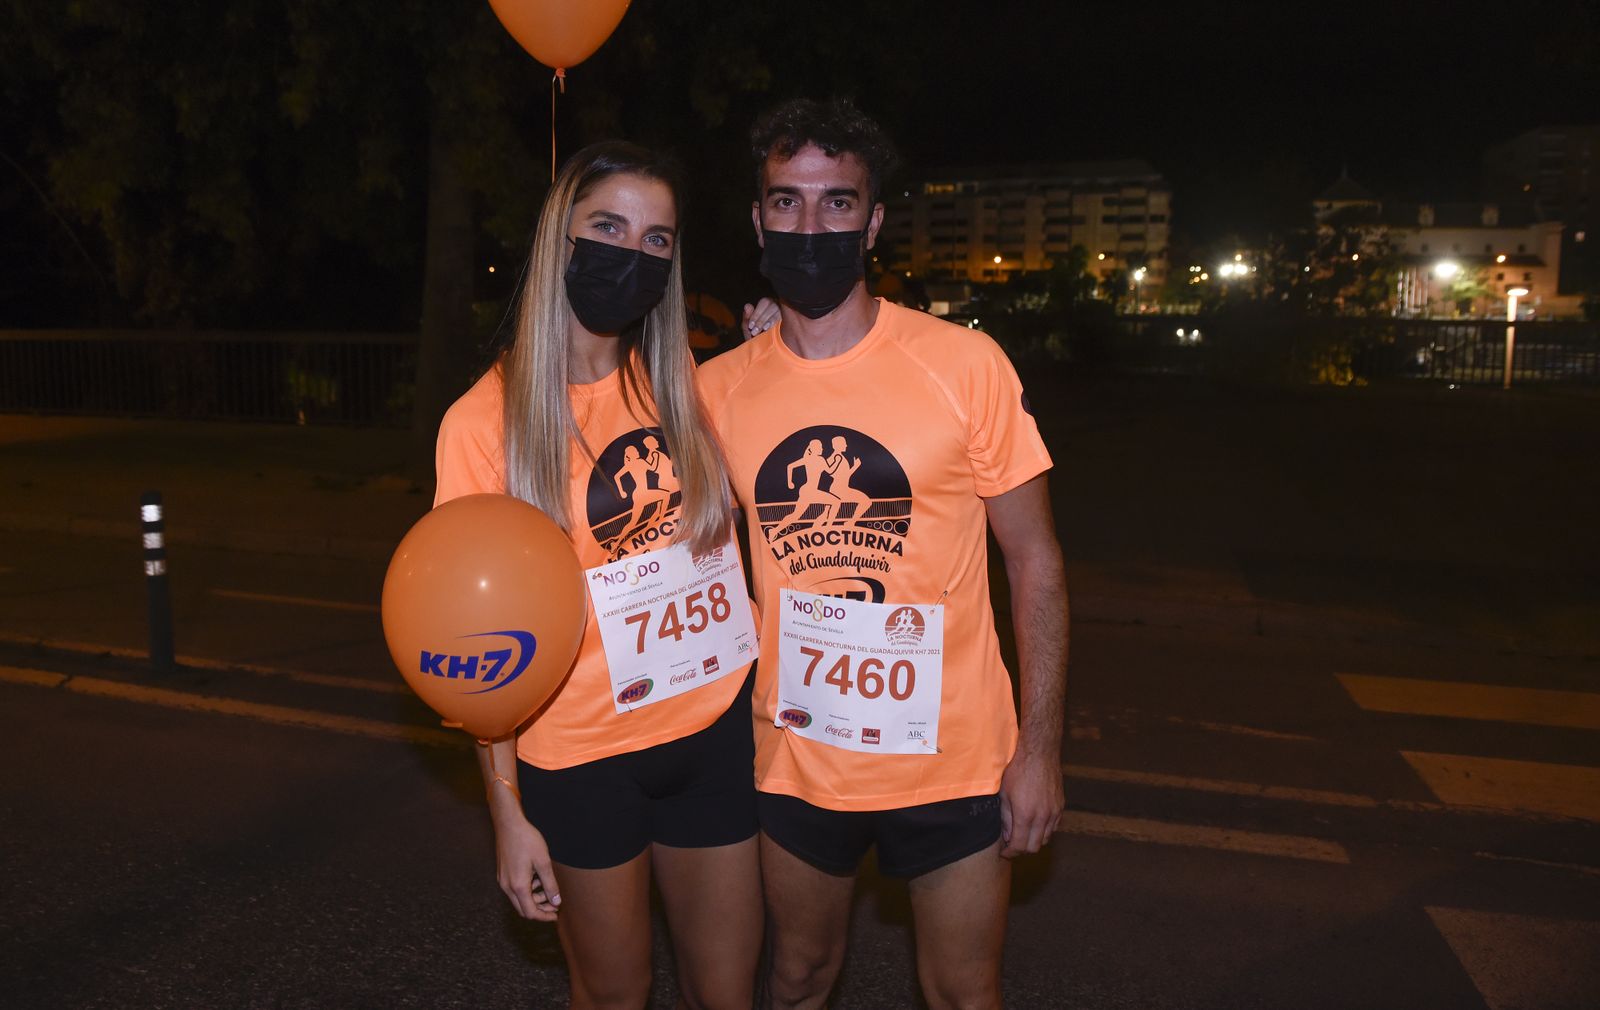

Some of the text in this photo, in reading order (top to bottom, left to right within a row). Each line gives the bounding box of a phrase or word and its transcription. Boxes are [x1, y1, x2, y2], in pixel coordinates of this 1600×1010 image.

[772, 530, 903, 561] LA NOCTURNA
[789, 550, 891, 575] del Guadalquivir
[620, 600, 647, 614] CARRERA
[647, 590, 678, 605] NOCTURNA
[678, 586, 687, 595] DEL
[687, 570, 721, 590] GUADALQUIVIR
[625, 582, 731, 655] 7458
[783, 631, 799, 640] XXXIII
[799, 635, 823, 646] CARRERA
[823, 641, 856, 651] NOCTURNA
[869, 647, 914, 656] GUADALQUIVIR
[420, 648, 512, 682] KH-7
[800, 645, 915, 701] 7460
[907, 730, 926, 738] ABC
